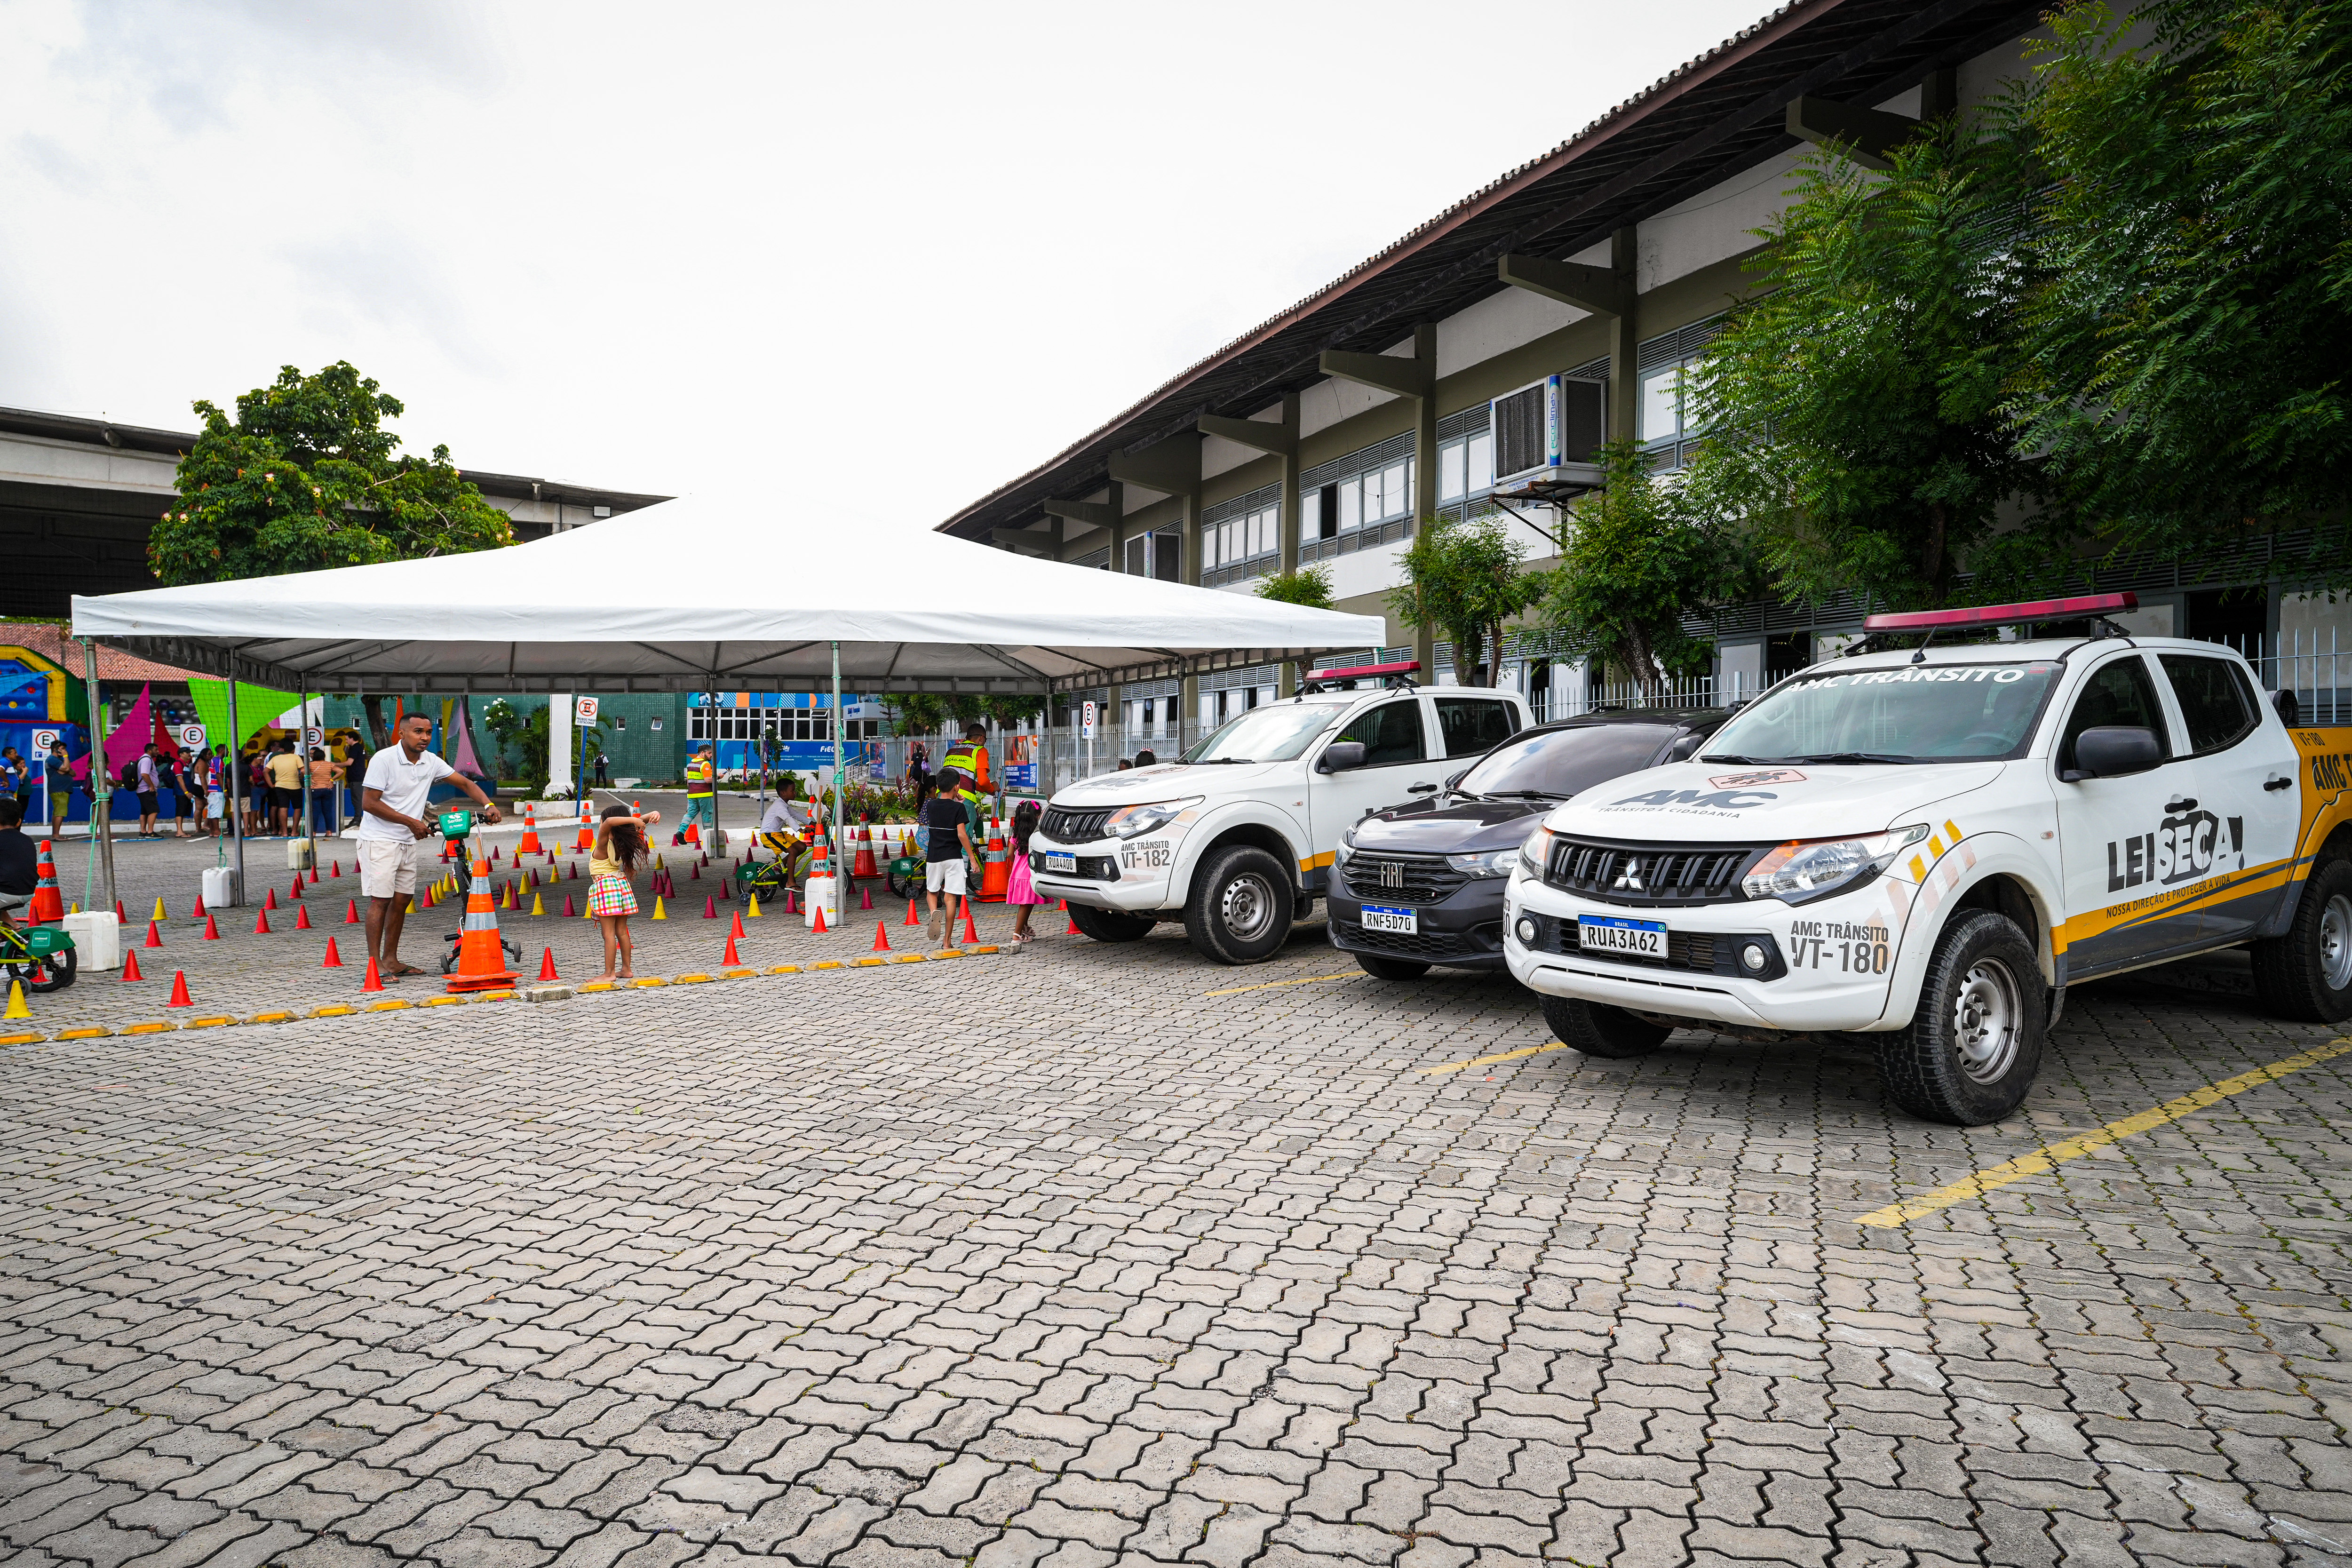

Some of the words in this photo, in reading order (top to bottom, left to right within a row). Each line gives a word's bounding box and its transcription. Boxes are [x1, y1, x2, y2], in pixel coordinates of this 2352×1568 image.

[1777, 674, 1848, 695] AMC
[1849, 666, 2025, 686] TRÂNSITO
[1087, 708, 1090, 721] E
[42, 735, 50, 745] E
[190, 731, 197, 740] E
[309, 732, 316, 741] E
[2296, 732, 2325, 746] VT-180
[2312, 754, 2347, 791] AMC
[1078, 778, 1149, 787] AMC
[1608, 790, 1778, 809] AMC
[1669, 808, 1740, 819] CIDADANIA
[1121, 843, 1135, 852] AMC
[1137, 840, 1169, 851] TRÂNSITO
[1049, 857, 1073, 870] RUA4A00
[1121, 849, 1170, 869] VT-182
[2107, 832, 2155, 893] LEI
[1381, 862, 1405, 888] FIAT
[2106, 905, 2131, 919] NOSSA
[2133, 892, 2164, 911] DIREÇÃO
[2167, 891, 2171, 901] E
[2172, 880, 2208, 900] PROTEGER
[2209, 879, 2213, 889] A
[2216, 874, 2231, 887] VIDA
[1367, 913, 1411, 931] RNF5D70
[1588, 926, 1658, 953] RUA3A62
[1791, 921, 1822, 937] AMC
[1826, 921, 1889, 943] TRÂNSITO
[1790, 937, 1888, 975] VT-180
